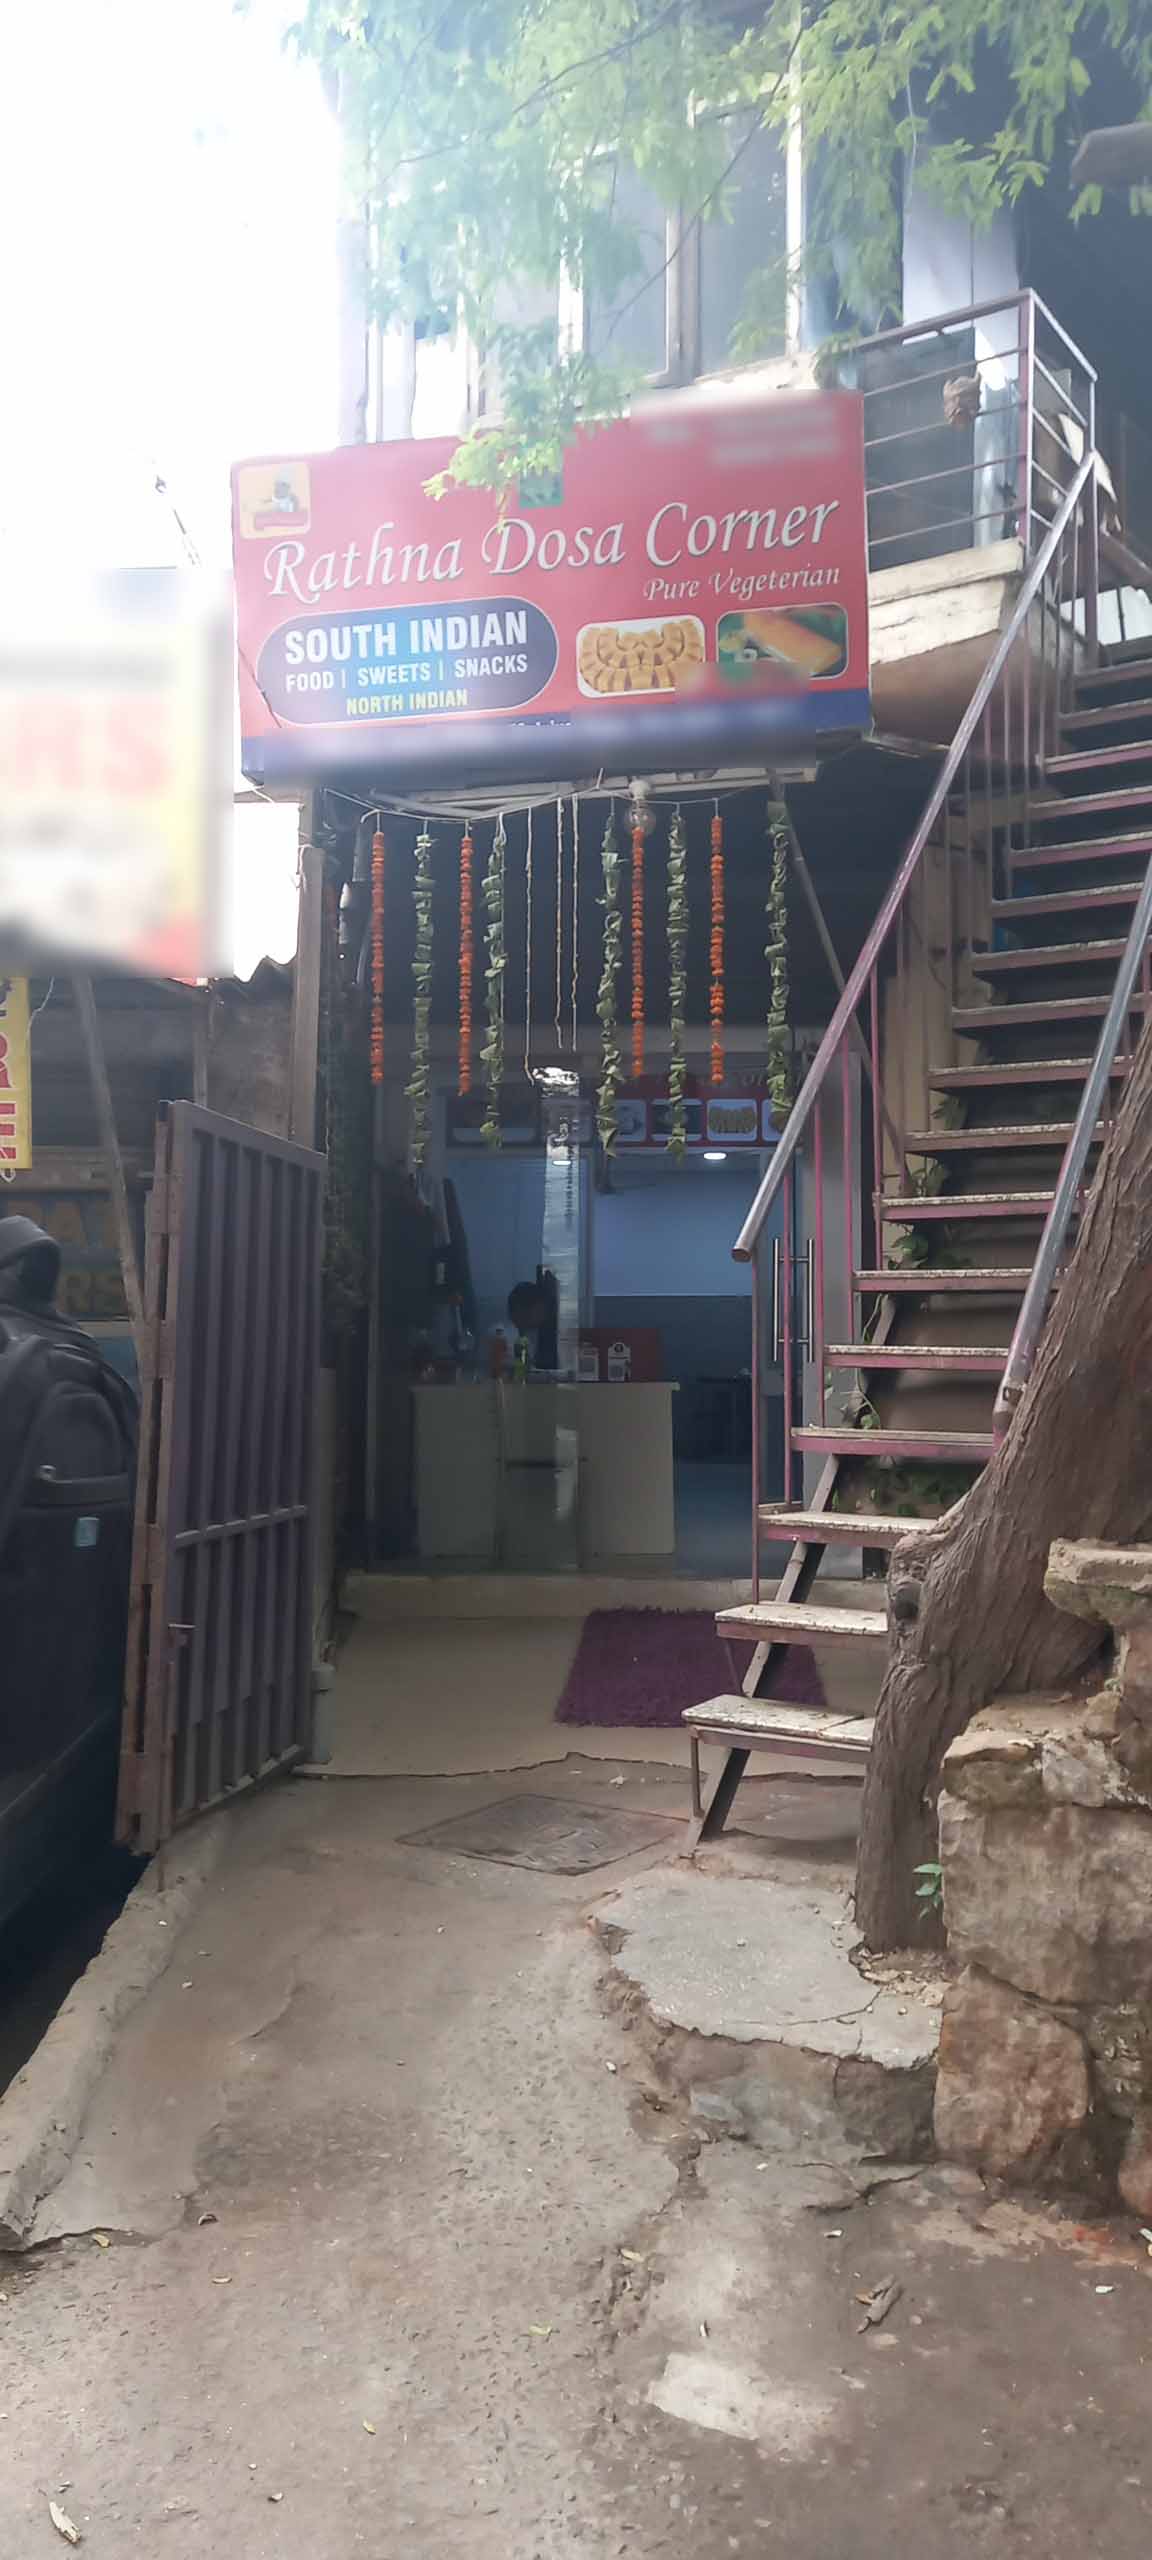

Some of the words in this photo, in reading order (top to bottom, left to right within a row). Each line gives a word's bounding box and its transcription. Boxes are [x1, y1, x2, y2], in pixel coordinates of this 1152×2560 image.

[263, 520, 465, 604] Rathna
[480, 517, 626, 576] Dosa
[645, 501, 840, 568] Corner
[643, 577, 700, 601] Pure
[708, 563, 841, 600] Vegeterian
[284, 622, 397, 666] SOUTH
[409, 610, 528, 655] INDIAN
[285, 670, 334, 693] FOOD
[357, 661, 432, 688] SWEETS
[454, 653, 528, 679] SNACKS
[346, 694, 405, 716] NORTH
[409, 688, 470, 711] INDIAN
